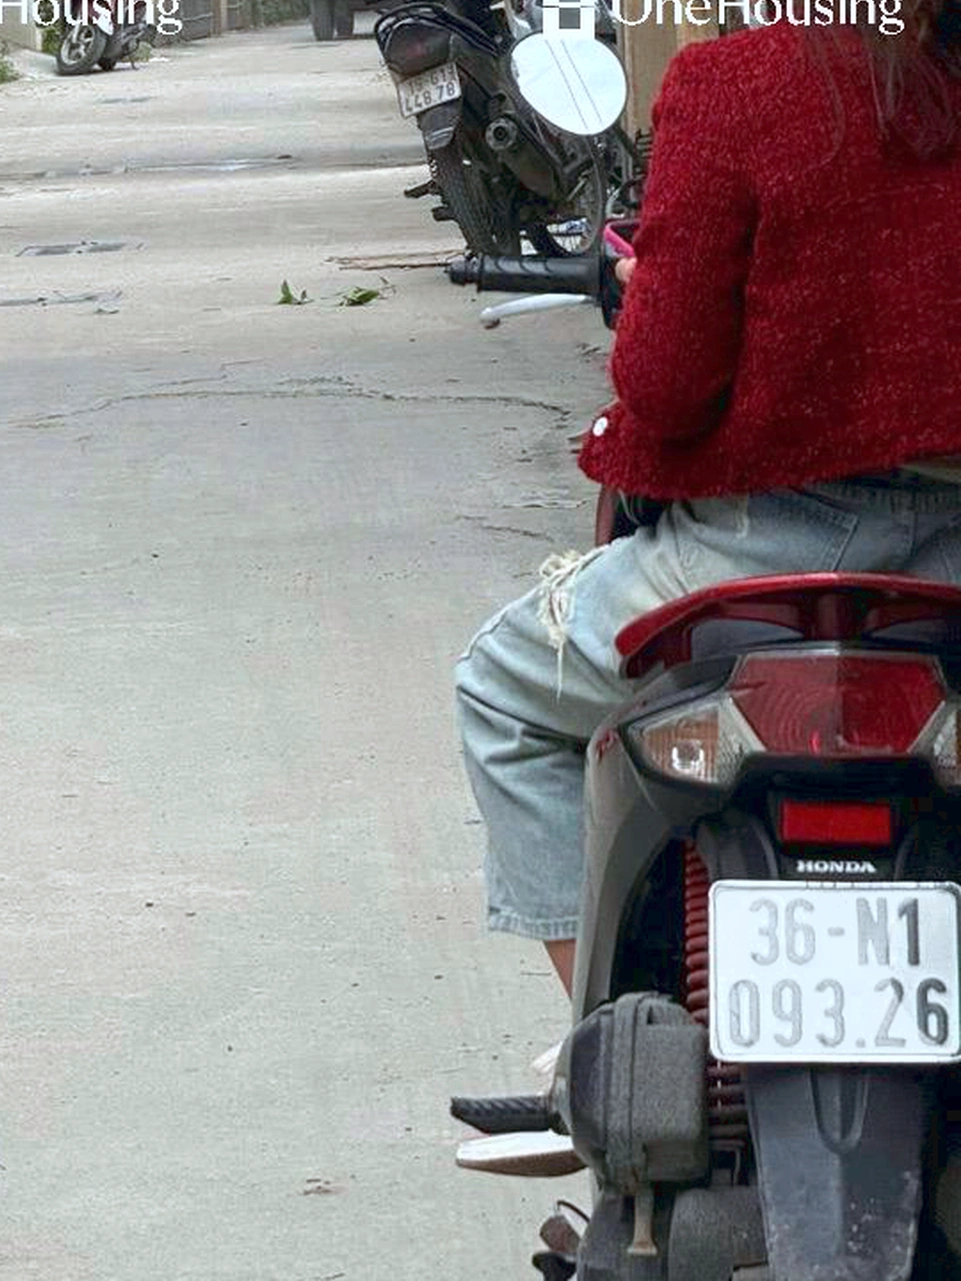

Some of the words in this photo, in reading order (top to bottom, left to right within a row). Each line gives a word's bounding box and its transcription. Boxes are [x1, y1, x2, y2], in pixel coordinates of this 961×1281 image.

[796, 859, 877, 874] HONDA
[748, 897, 920, 966] 36-N1
[728, 976, 950, 1048] 093.26
